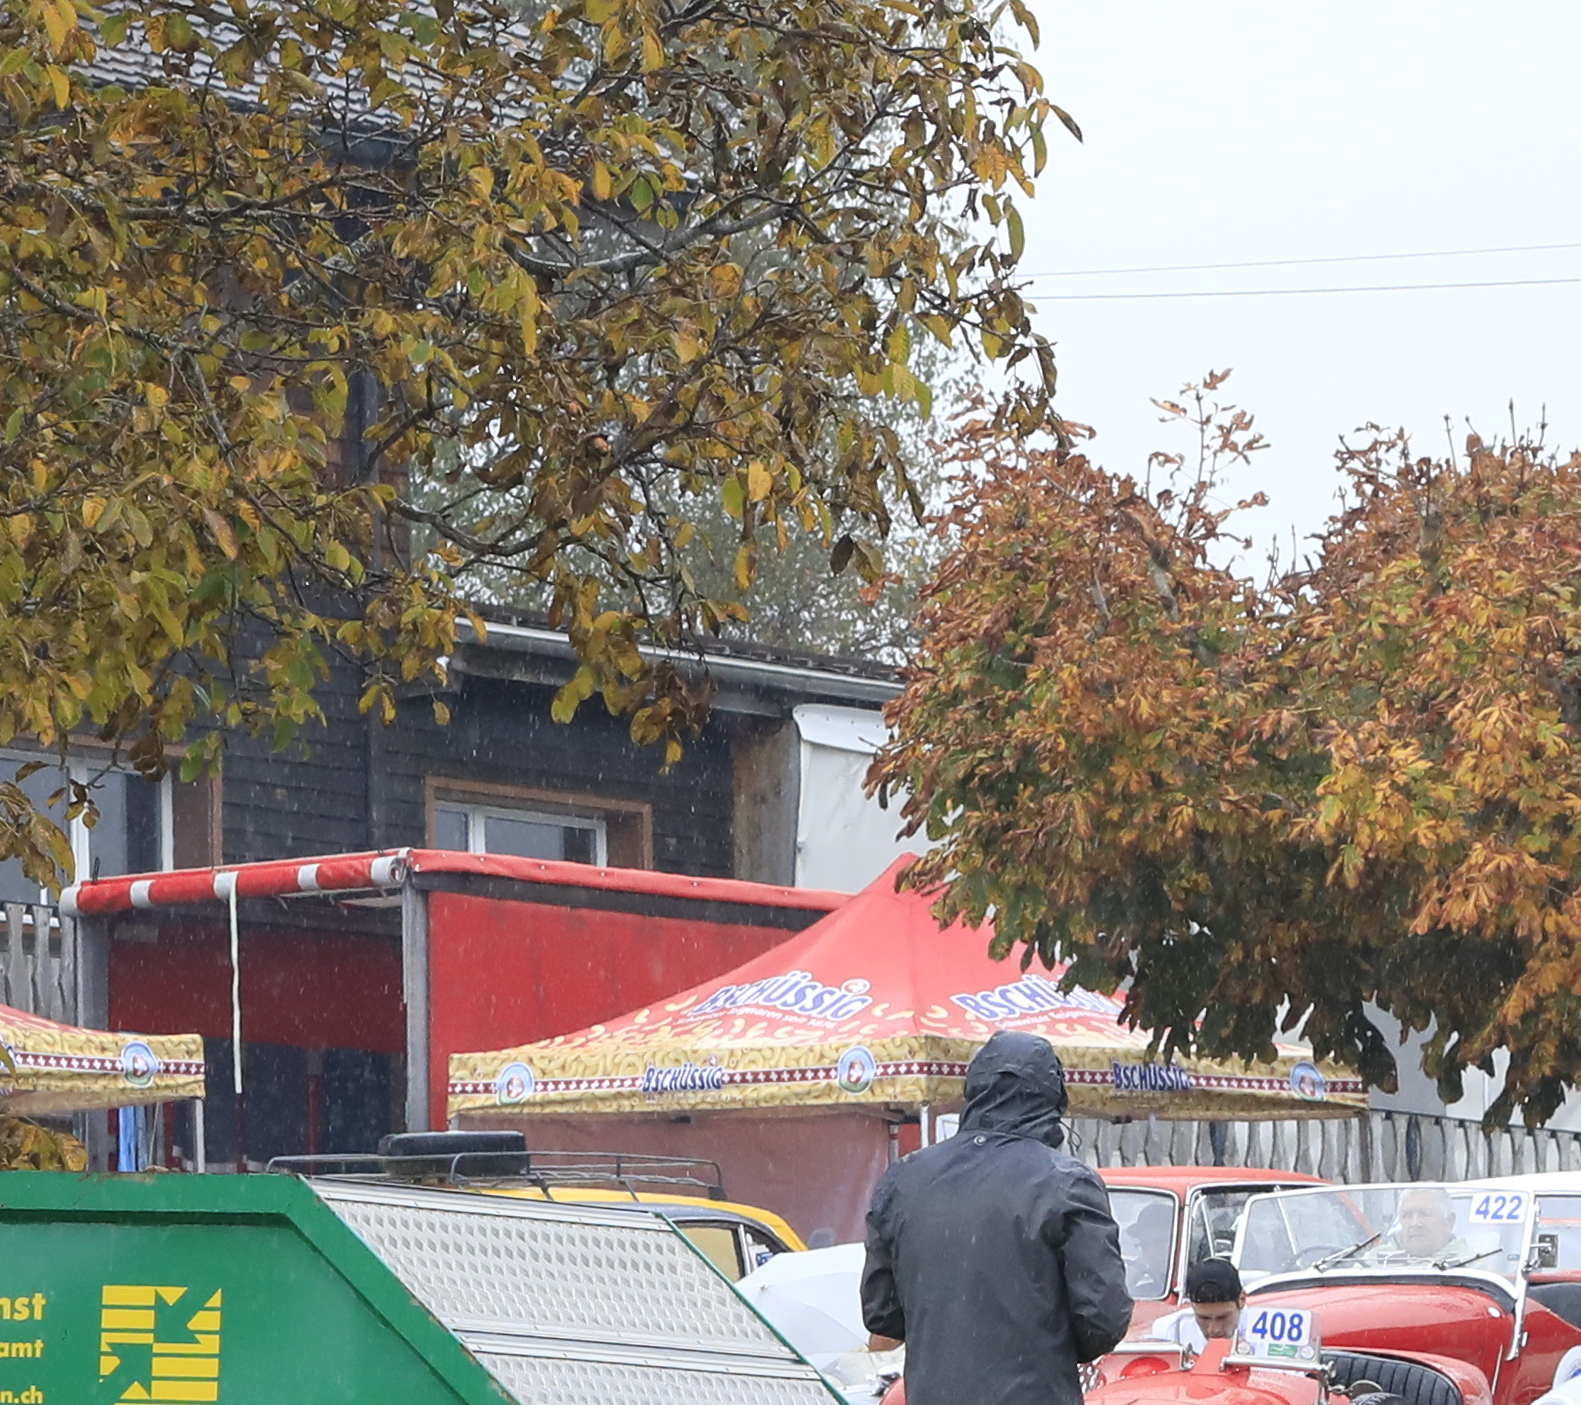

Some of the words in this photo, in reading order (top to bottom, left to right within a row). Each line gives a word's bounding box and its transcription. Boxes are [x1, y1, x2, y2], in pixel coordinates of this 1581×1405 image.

[689, 970, 873, 1021] BSCHÜSSIG
[641, 1064, 723, 1094] BSCHÜSSIG
[1475, 1195, 1522, 1220] 422
[1252, 1311, 1303, 1342] 408
